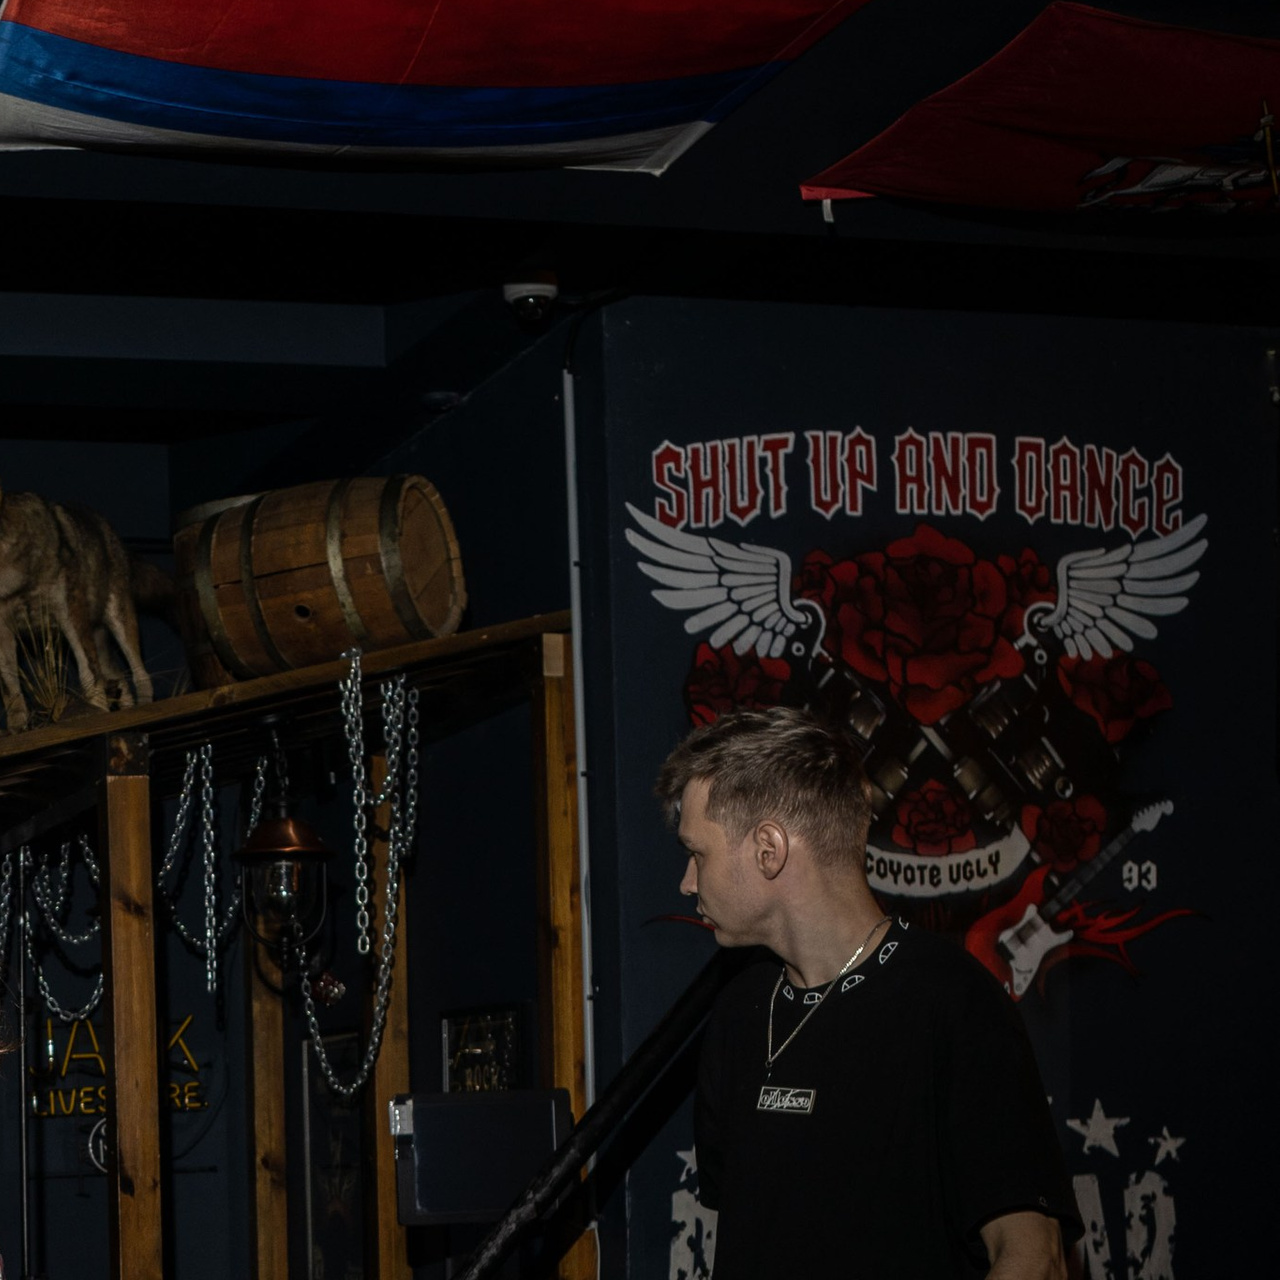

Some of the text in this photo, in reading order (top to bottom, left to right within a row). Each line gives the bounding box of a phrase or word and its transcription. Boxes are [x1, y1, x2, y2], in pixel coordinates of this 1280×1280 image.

[651, 425, 1185, 539] SHUT UP AND DANCE
[949, 850, 1001, 884] UGLY
[1122, 859, 1158, 892] 93
[28, 1013, 200, 1078] JAK
